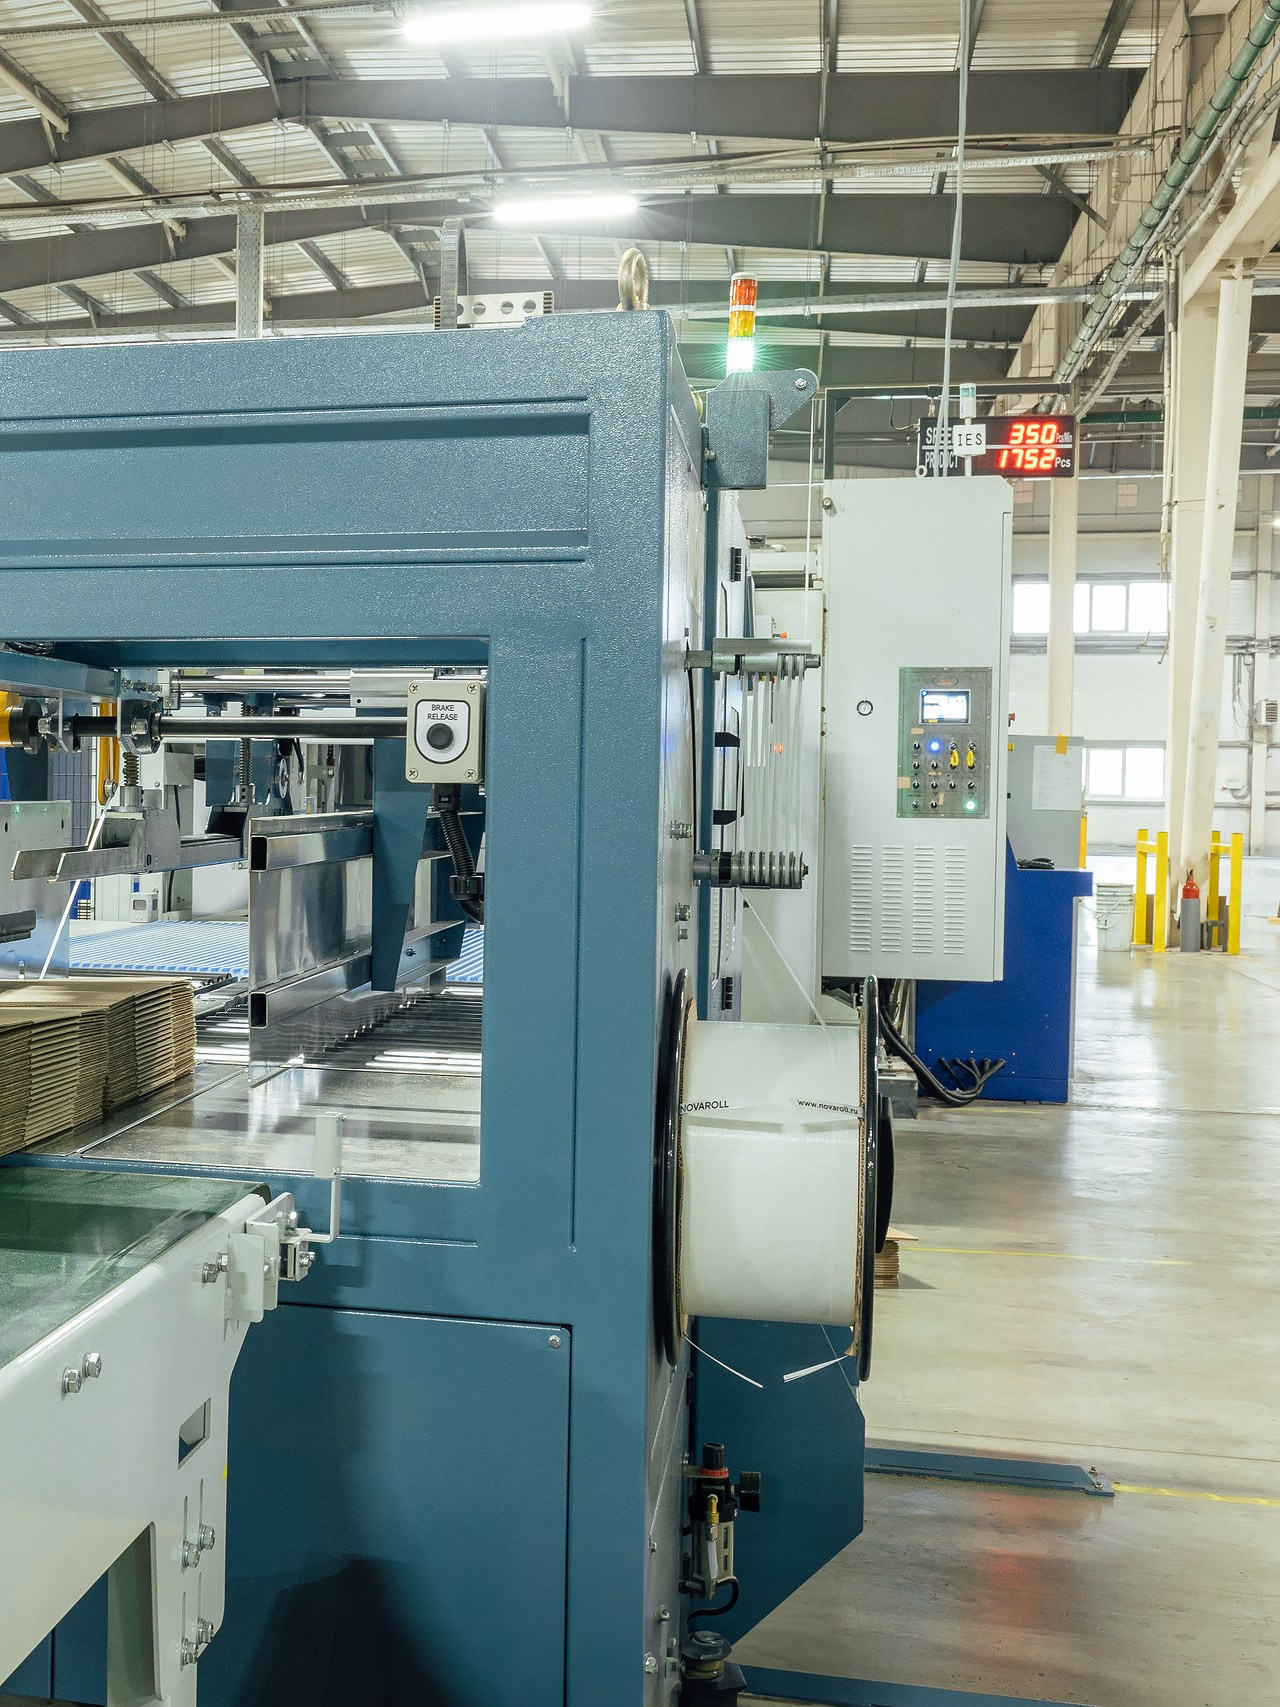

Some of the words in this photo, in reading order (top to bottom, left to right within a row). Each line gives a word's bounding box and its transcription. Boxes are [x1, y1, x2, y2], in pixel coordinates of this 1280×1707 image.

[926, 427, 953, 444] SPEE
[1010, 424, 1057, 444] 350
[1001, 448, 1056, 469] 1752
[1055, 457, 1071, 468] Pcs
[680, 1100, 729, 1112] NOVAROLL
[797, 1100, 858, 1114] www.novaroll.ru
